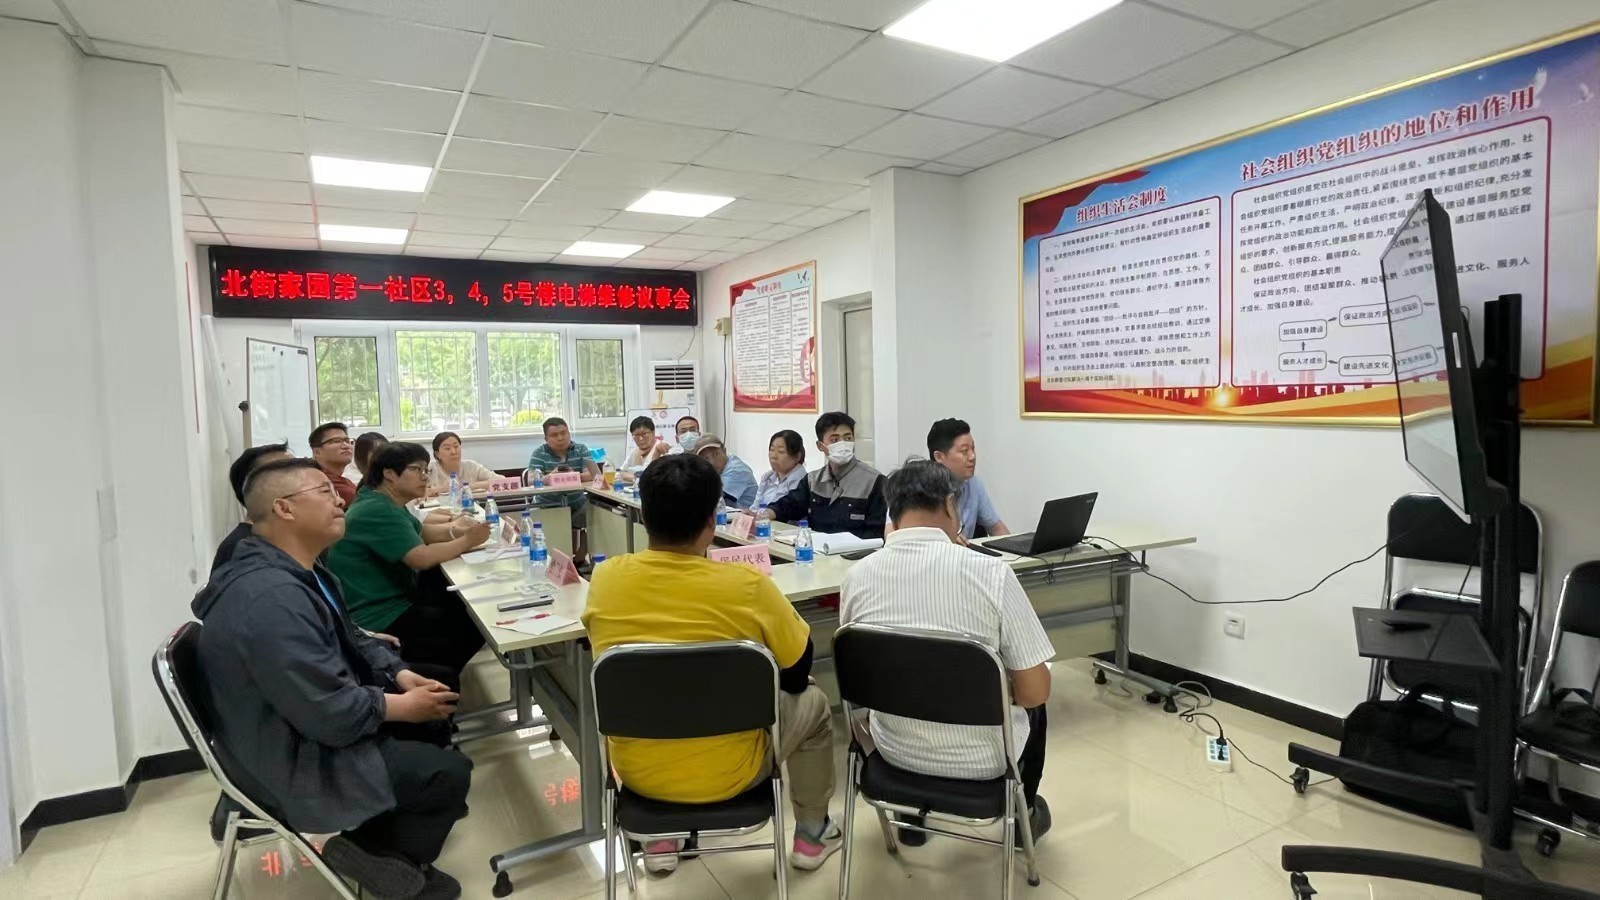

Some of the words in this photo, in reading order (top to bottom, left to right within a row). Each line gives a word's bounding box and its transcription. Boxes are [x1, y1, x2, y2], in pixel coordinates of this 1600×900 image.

[1241, 85, 1535, 181] 社会组织党组织的地位和作用
[1076, 186, 1168, 223] 组织生活会制度
[221, 269, 691, 310] 北街家园第一社区3，4，5号楼电梯维修议事会
[1342, 360, 1390, 371] 建设先进文化
